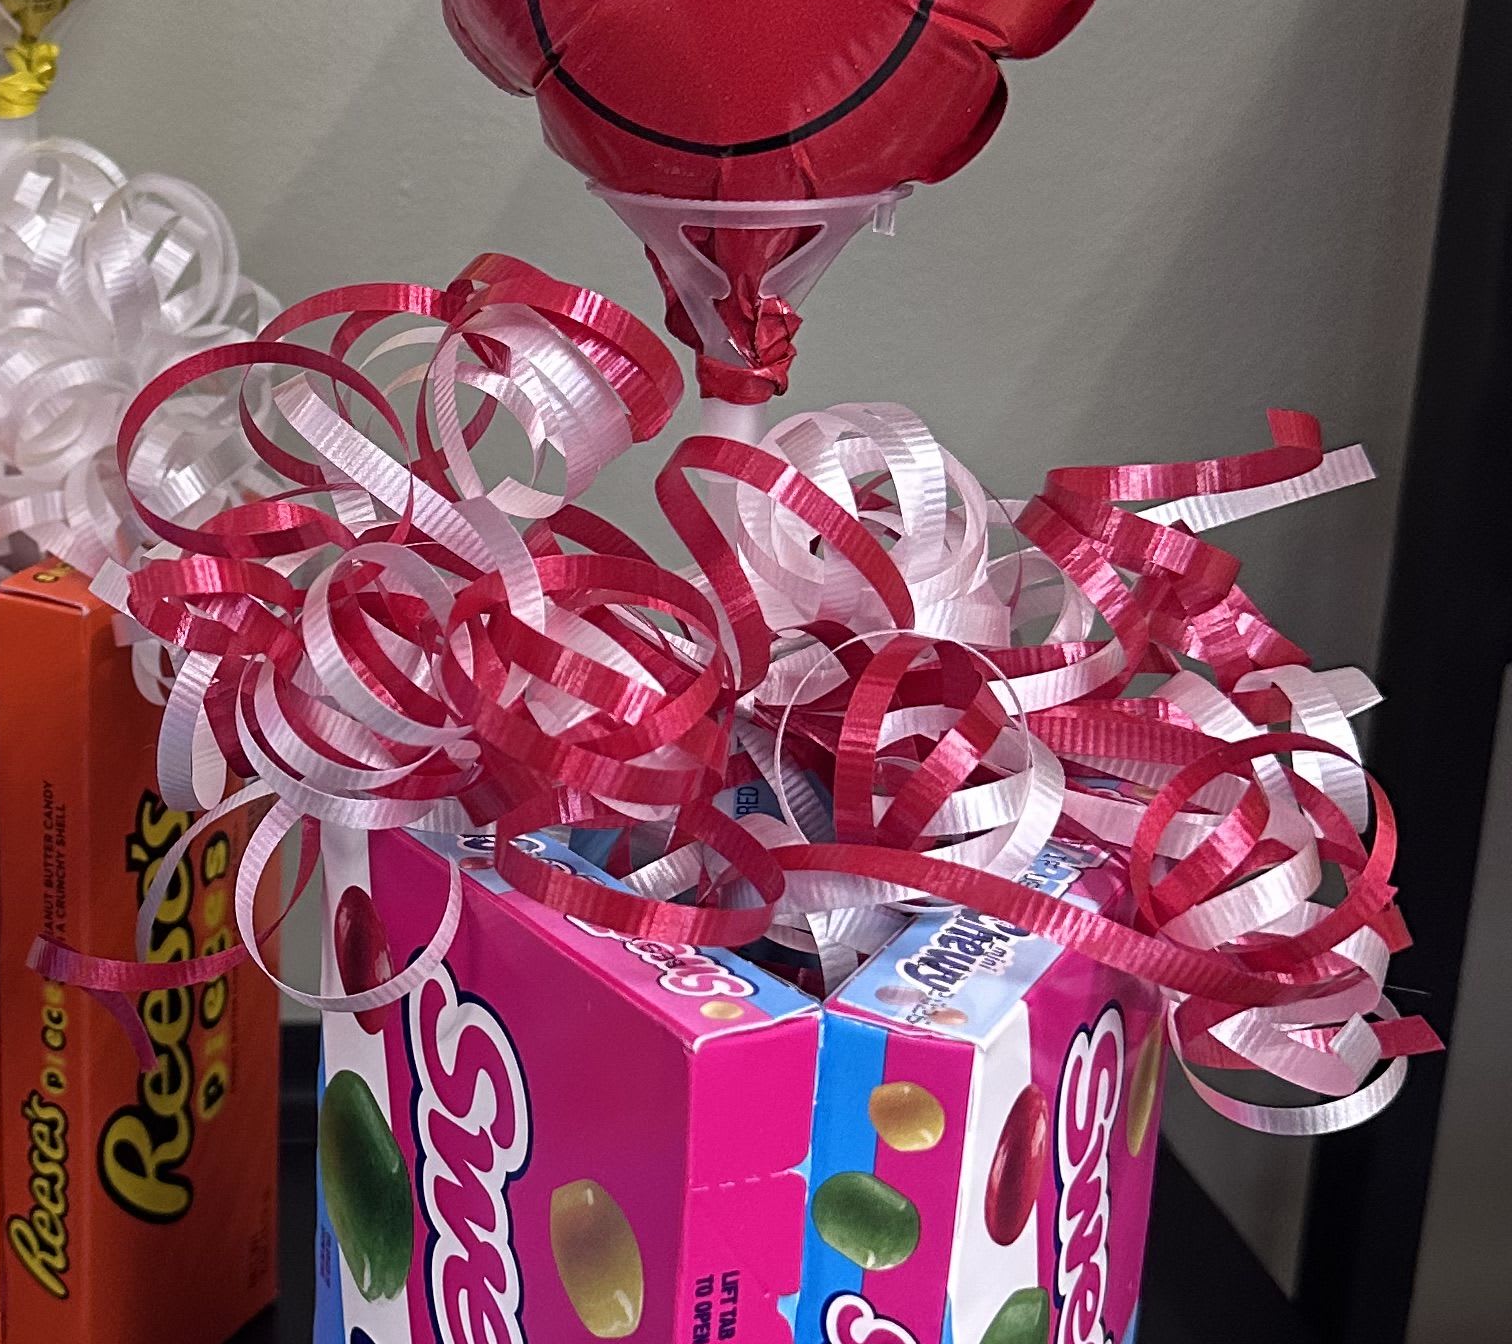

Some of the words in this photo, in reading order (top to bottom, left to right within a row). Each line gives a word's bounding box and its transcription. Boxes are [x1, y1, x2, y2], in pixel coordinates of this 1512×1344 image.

[43, 780, 55, 830] CANDY
[55, 804, 66, 848] SHELL
[43, 834, 55, 888] BUTTER
[98, 791, 194, 1222] Reese's
[7, 1090, 70, 1299] Reese's
[694, 1273, 715, 1298] TO
[719, 1270, 740, 1306] LIFT
[717, 1307, 738, 1341] TAB
